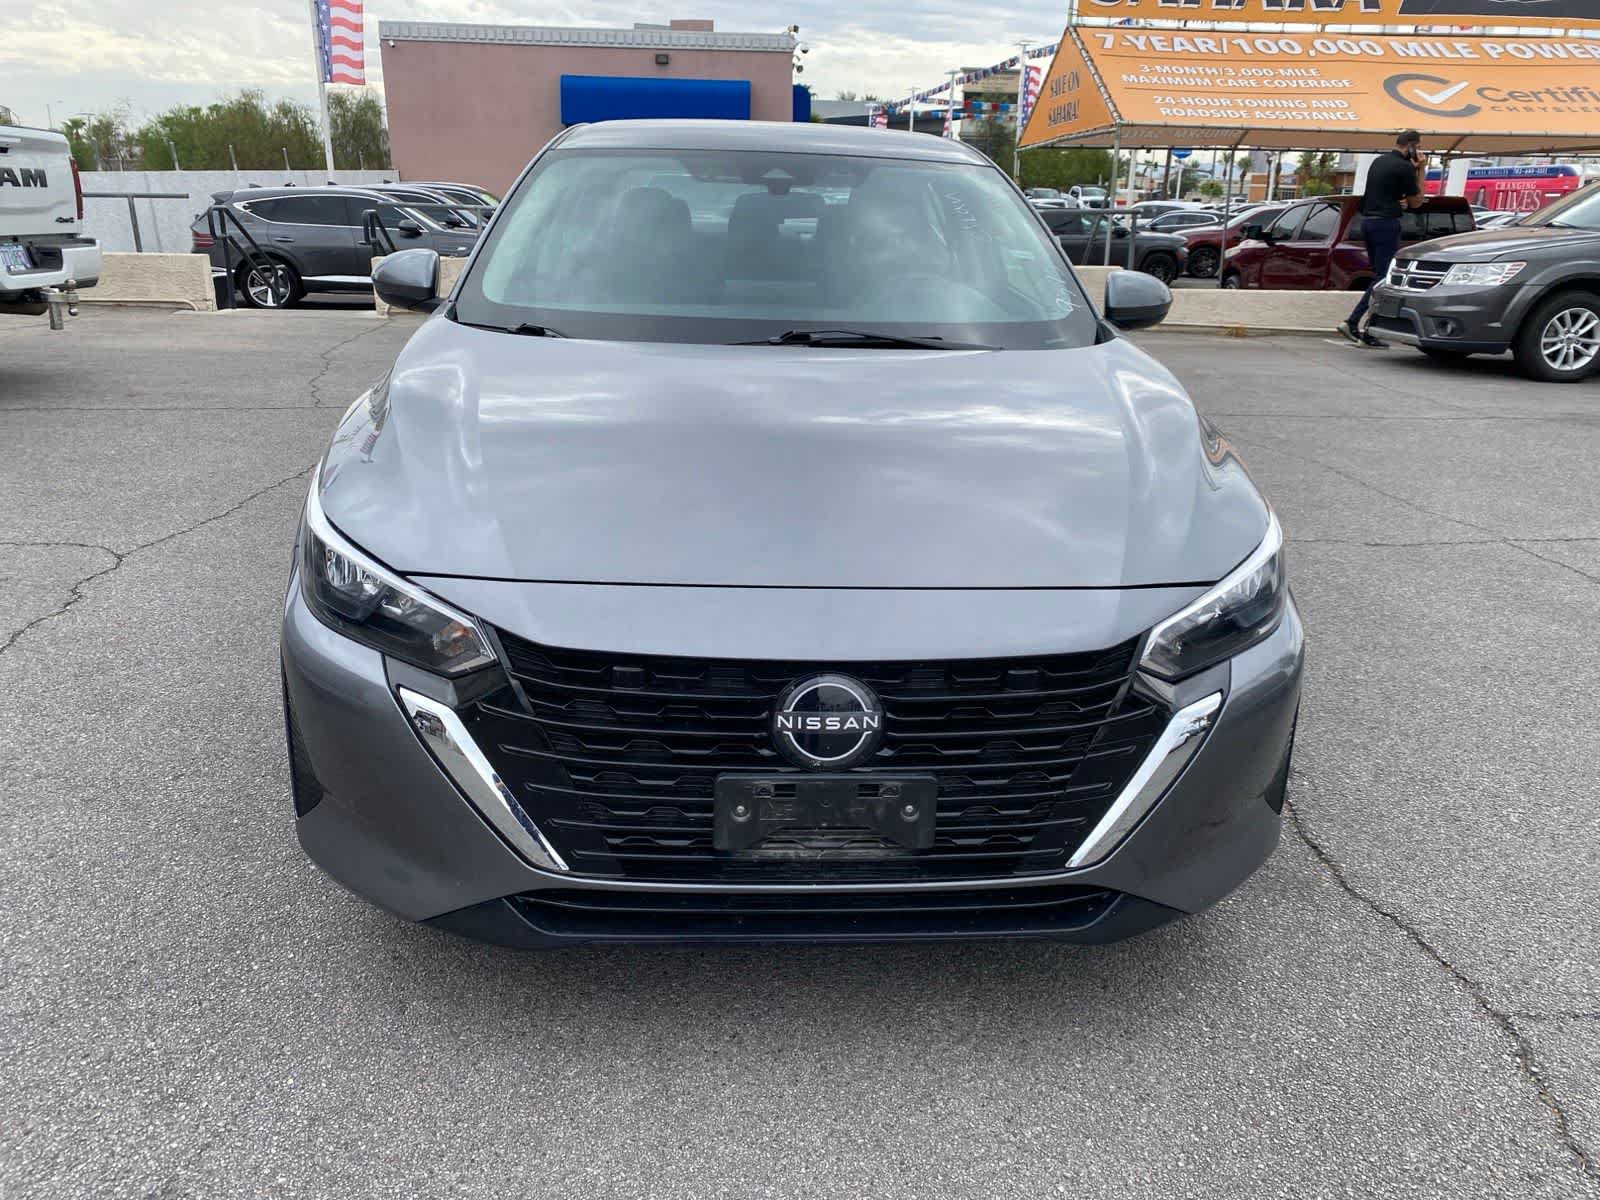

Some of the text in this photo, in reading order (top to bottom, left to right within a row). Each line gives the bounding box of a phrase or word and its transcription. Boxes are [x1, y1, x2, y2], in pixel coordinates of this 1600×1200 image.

[1095, 33, 1384, 57] 7-YEAR/100,000
[1387, 40, 1480, 58] MILE
[1121, 74, 1353, 89] MAXIMUM CARE COVERAGE
[1153, 95, 1349, 109] 24-HOUR TOWING AND
[1159, 108, 1360, 121] ROADSIDE ASSISTANCE
[0, 167, 48, 188] AM
[1495, 190, 1542, 211] LIVES
[777, 715, 879, 730] NISSAN
